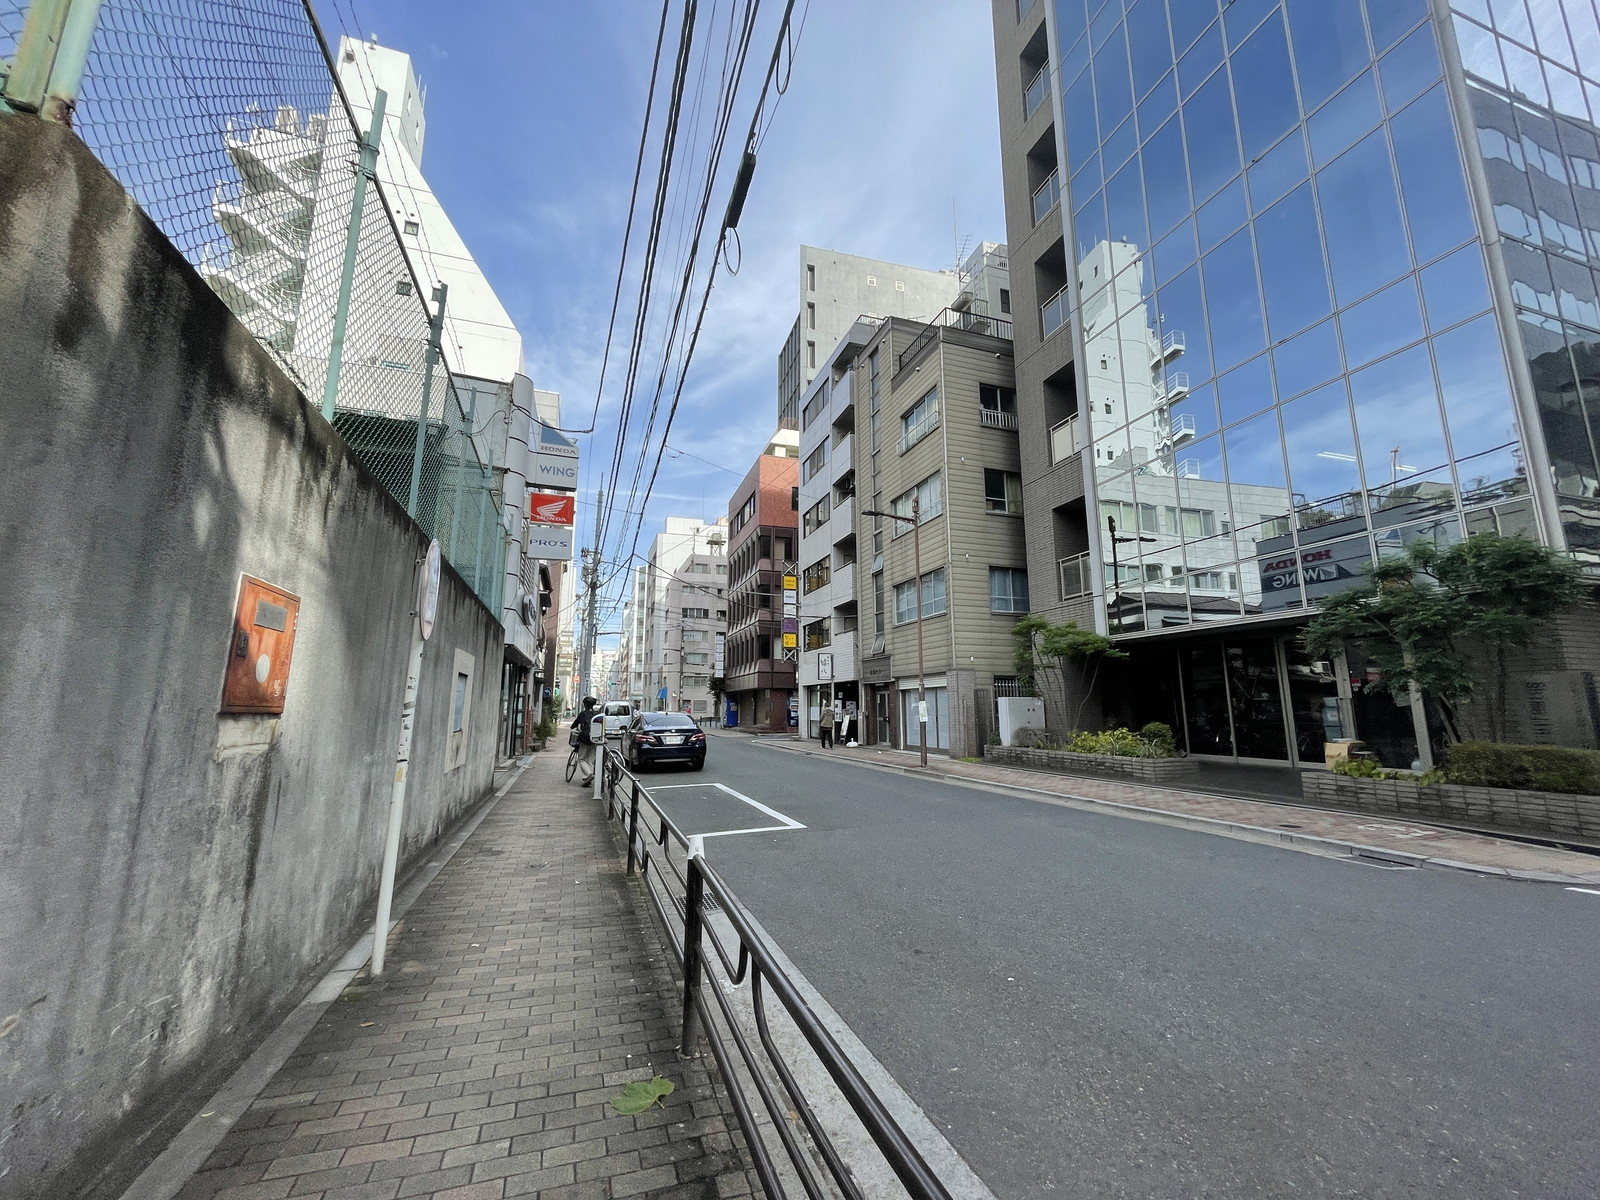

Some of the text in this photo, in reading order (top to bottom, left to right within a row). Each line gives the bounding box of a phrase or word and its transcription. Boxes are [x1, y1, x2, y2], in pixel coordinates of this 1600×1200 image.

[540, 446, 576, 455] HONDA
[540, 465, 575, 477] WING
[530, 539, 567, 548] PRO'S
